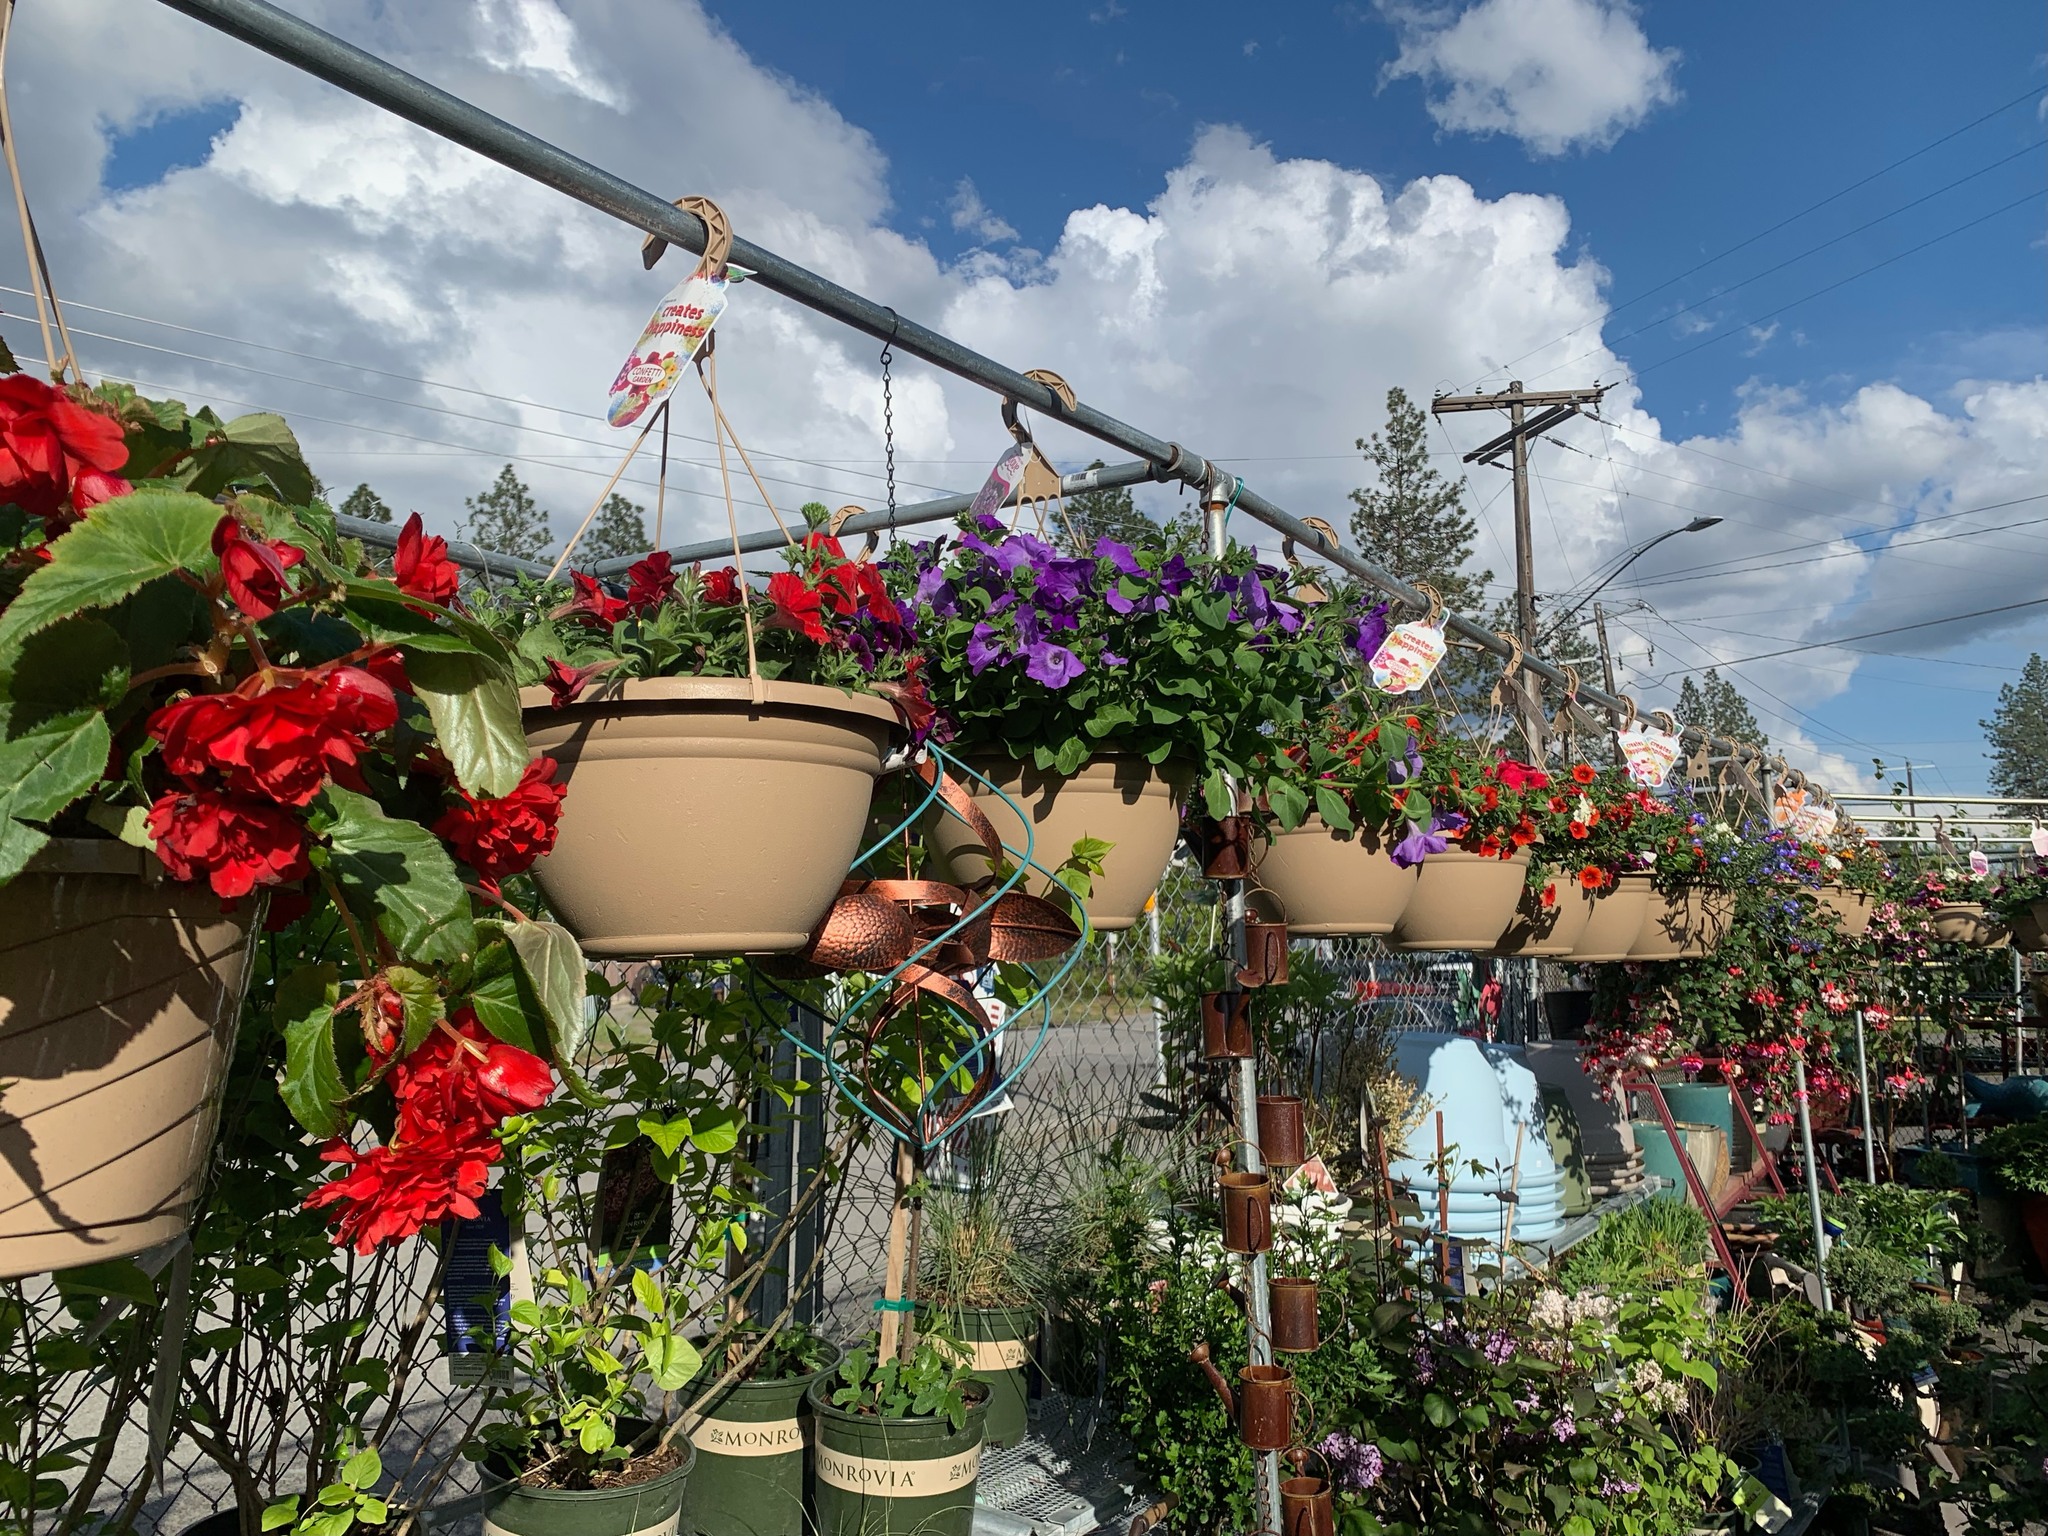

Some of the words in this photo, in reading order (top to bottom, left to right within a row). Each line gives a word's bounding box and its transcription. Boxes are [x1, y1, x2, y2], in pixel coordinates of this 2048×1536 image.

[662, 303, 704, 320] creates
[632, 367, 662, 378] CONFETTI
[632, 376, 654, 384] GARDEN
[1390, 634, 1437, 663] happiness
[1403, 633, 1434, 652] creates
[818, 1454, 914, 1488] MONROVIA
